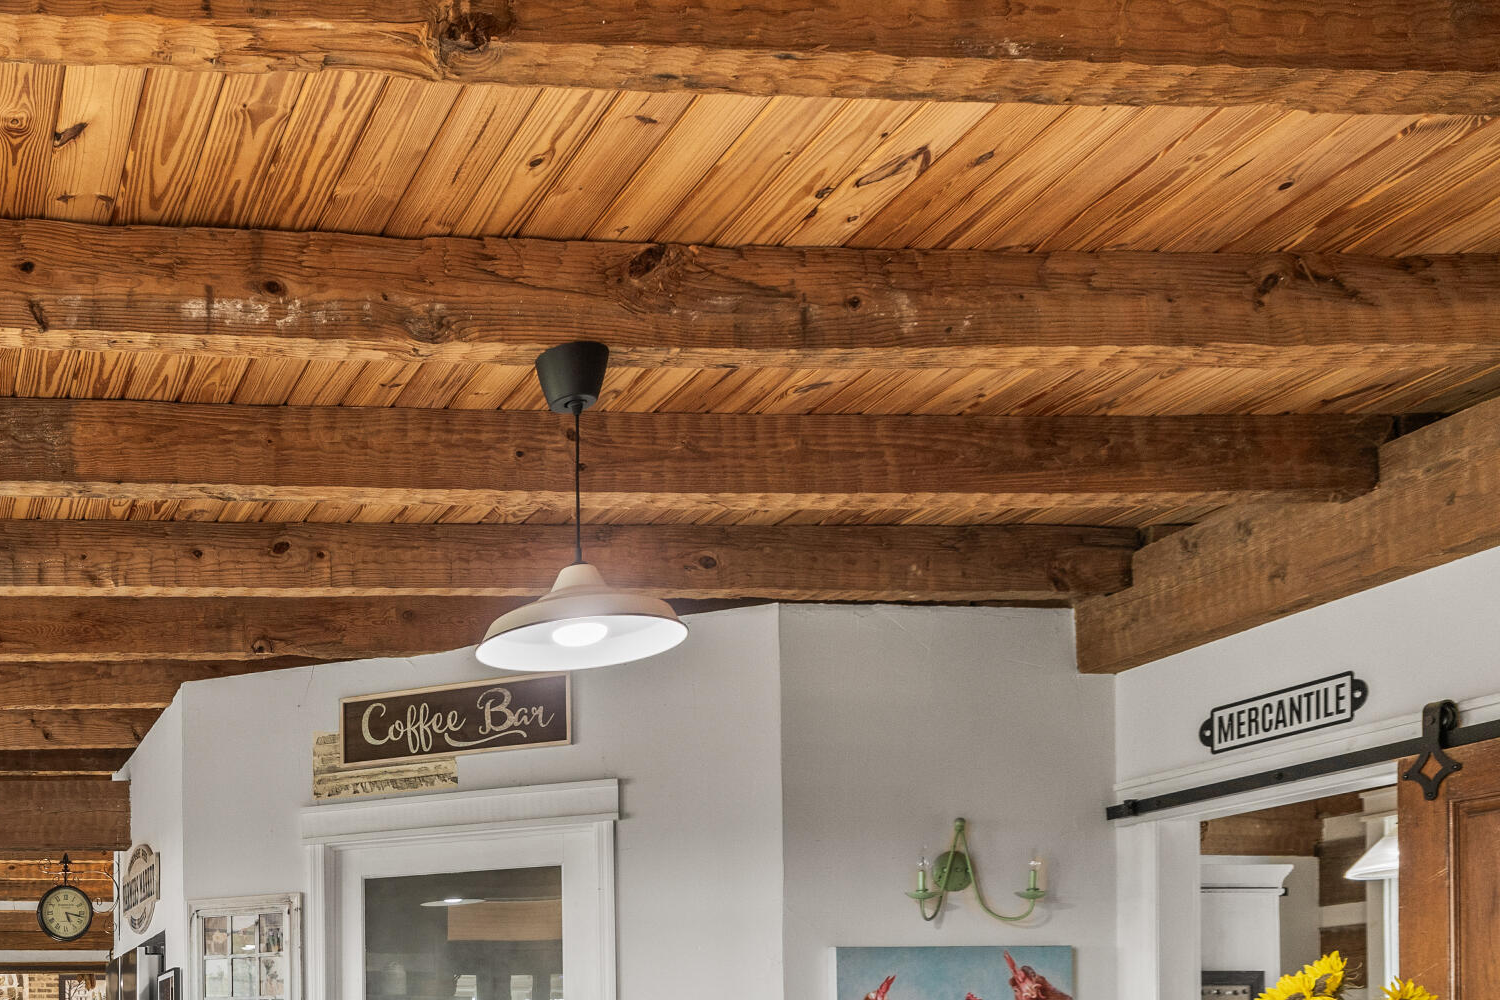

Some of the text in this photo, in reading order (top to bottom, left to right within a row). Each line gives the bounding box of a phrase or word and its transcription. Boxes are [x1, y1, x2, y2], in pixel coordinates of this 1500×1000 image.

[361, 687, 555, 754] Coffee Bar
[1217, 682, 1347, 744] MERCANTILE
